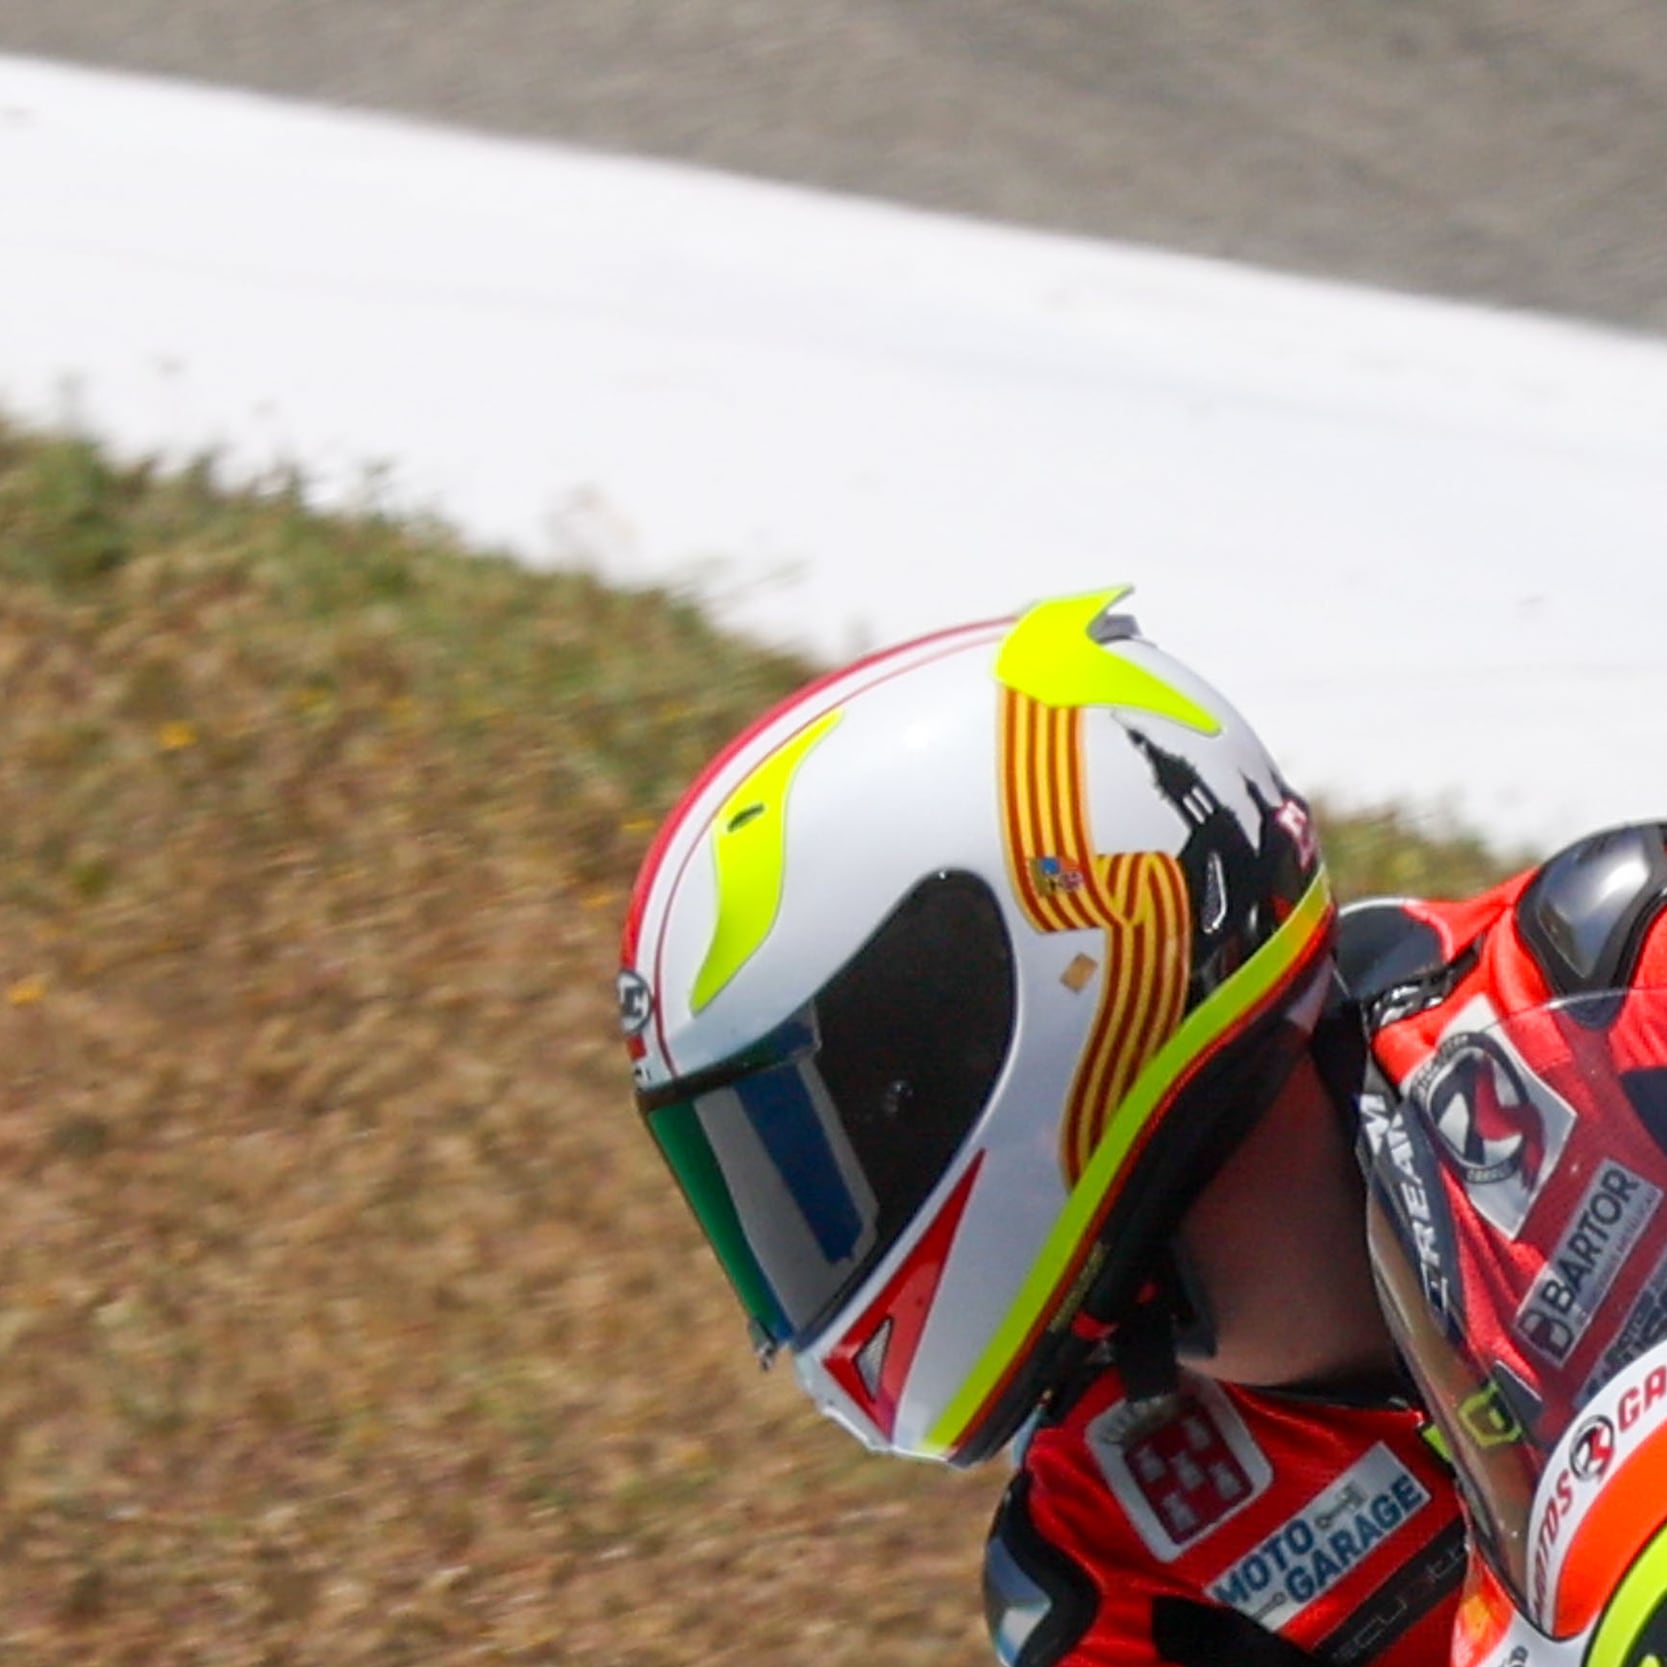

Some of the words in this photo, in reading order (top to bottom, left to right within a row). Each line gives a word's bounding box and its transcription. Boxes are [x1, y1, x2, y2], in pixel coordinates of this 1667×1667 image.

[1540, 1168, 1641, 1317] BARTOR
[1212, 1518, 1315, 1607] MOTO
[1285, 1473, 1423, 1604] GARAGE
